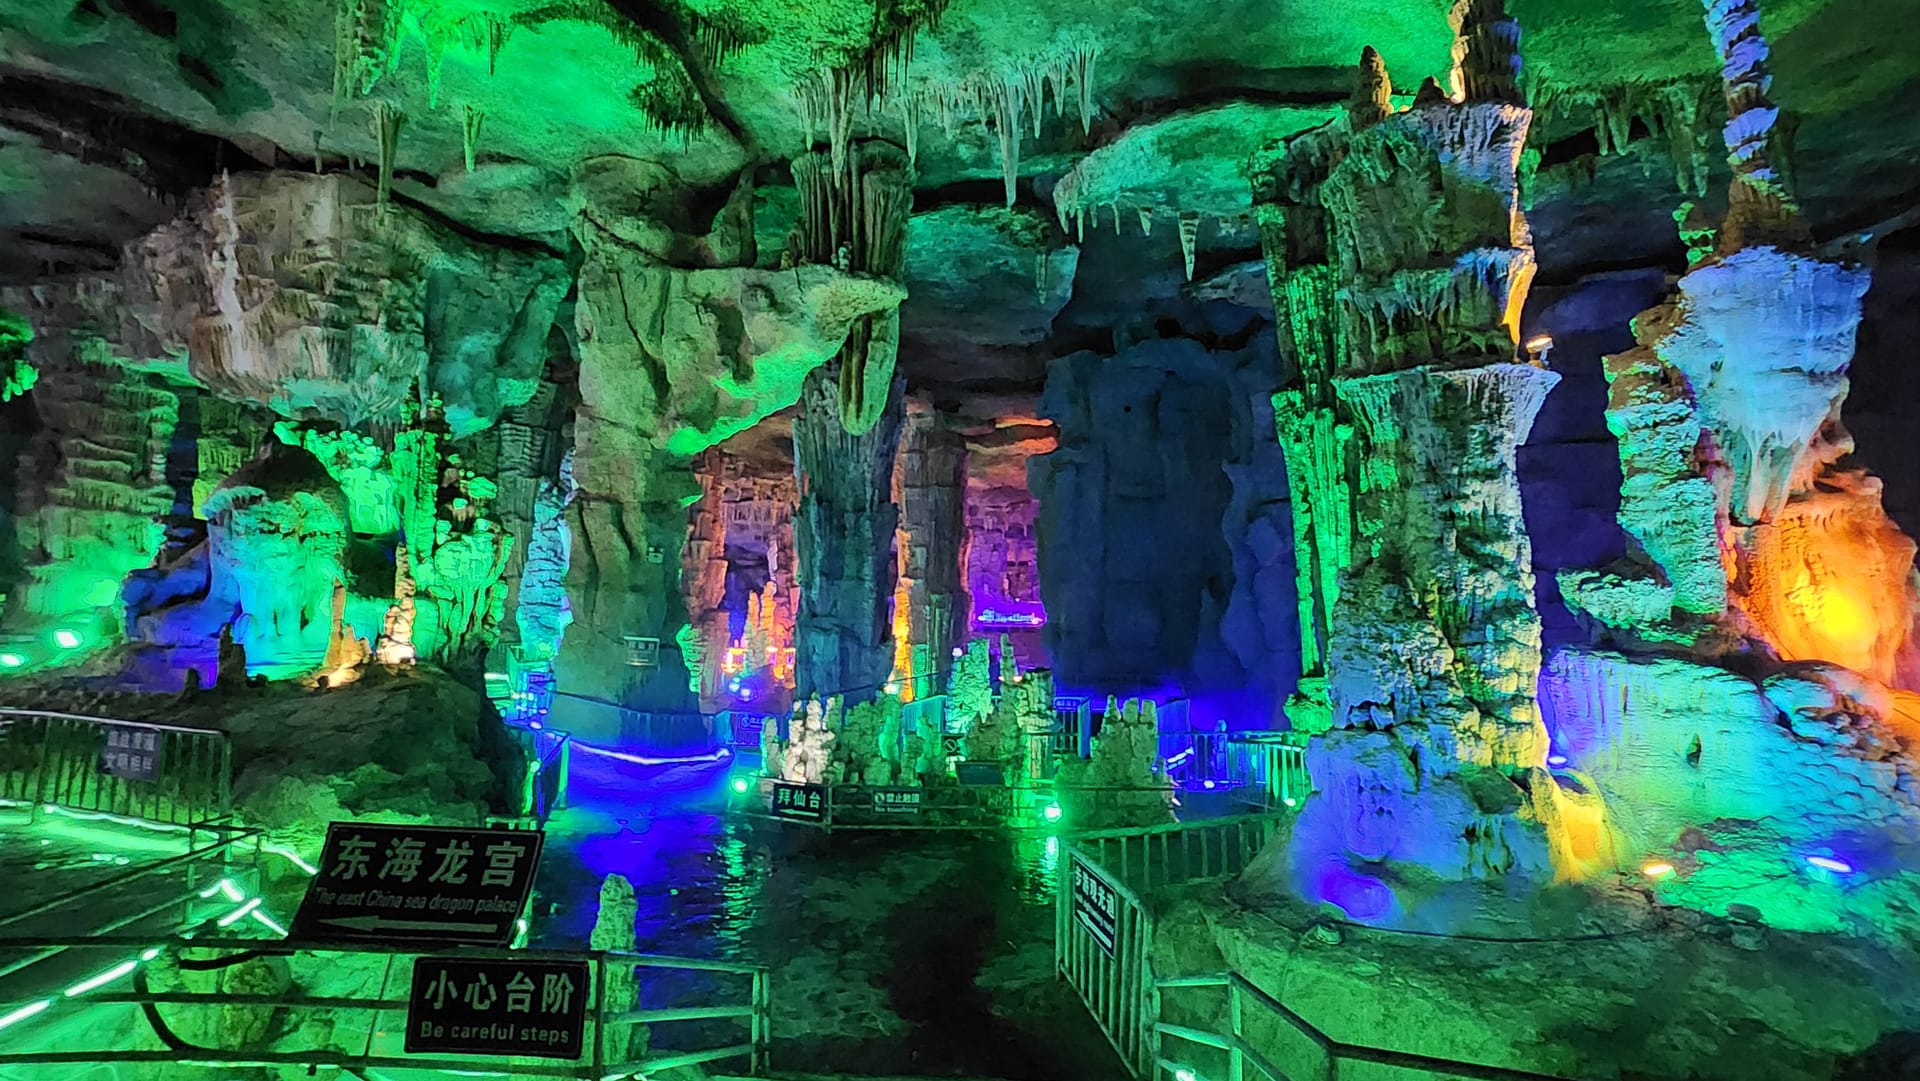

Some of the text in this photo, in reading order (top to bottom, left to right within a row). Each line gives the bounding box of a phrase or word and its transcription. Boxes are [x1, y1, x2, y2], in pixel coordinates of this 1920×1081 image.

[777, 788, 821, 809] 拜仙台
[330, 834, 526, 887] 东海龙宫
[315, 886, 518, 915] The east China sea dragon palace
[424, 969, 575, 1015] 小心台阶
[420, 1021, 570, 1046] Be careful steps
